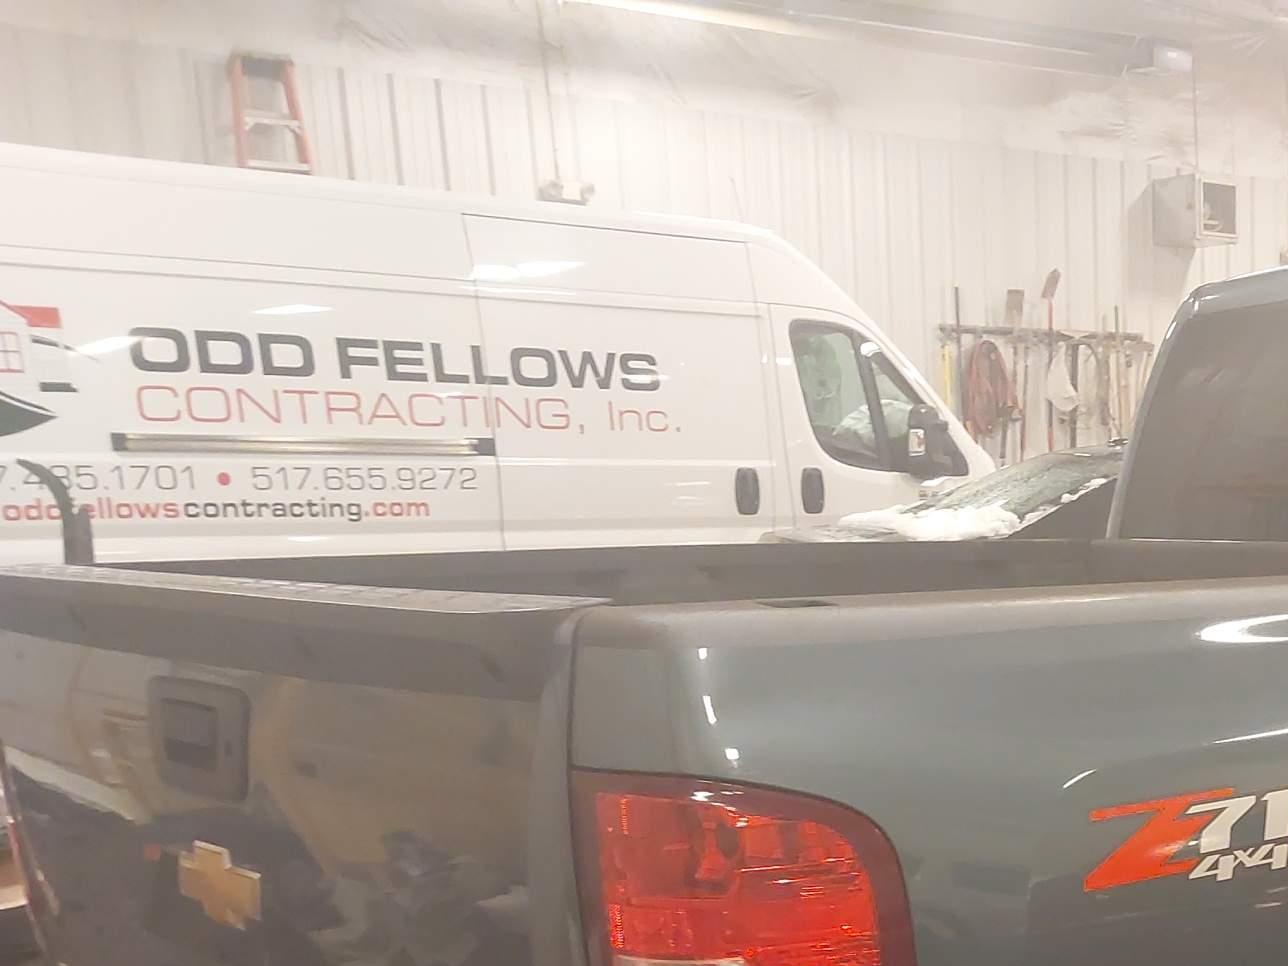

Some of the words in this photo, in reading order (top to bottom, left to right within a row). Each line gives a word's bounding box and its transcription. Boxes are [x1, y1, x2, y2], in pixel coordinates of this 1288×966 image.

[128, 326, 316, 377] ODD
[335, 336, 661, 391] FELLOWS
[136, 384, 585, 434] CONTRACTING,
[608, 400, 682, 432] Inc.
[250, 466, 478, 490] 517.655.9272
[2, 496, 430, 522] oddellowscontracting.com
